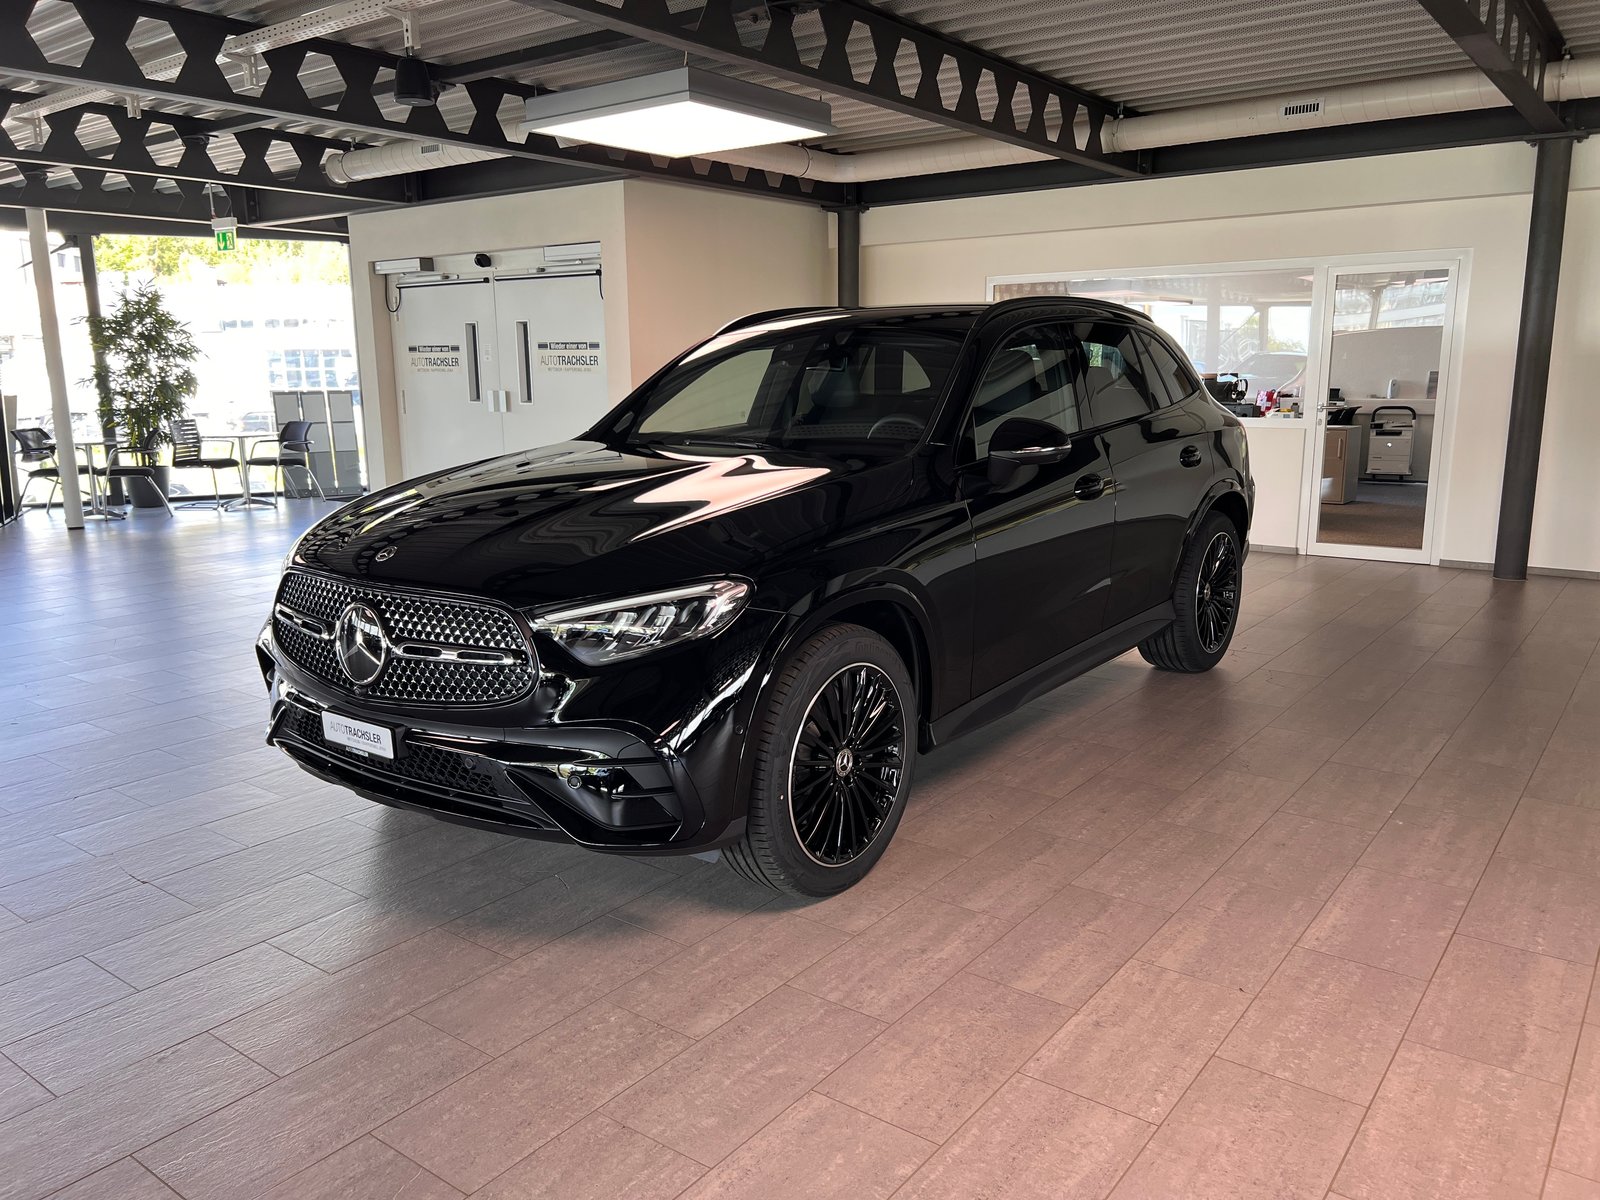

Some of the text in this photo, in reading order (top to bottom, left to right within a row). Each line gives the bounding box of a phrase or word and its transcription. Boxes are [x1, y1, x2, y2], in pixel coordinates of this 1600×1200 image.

[411, 357, 460, 367] AUTOTRACHSLER
[541, 355, 599, 366] AUTOTRACHSLER
[330, 721, 382, 745] AUTOTRACHSLER
